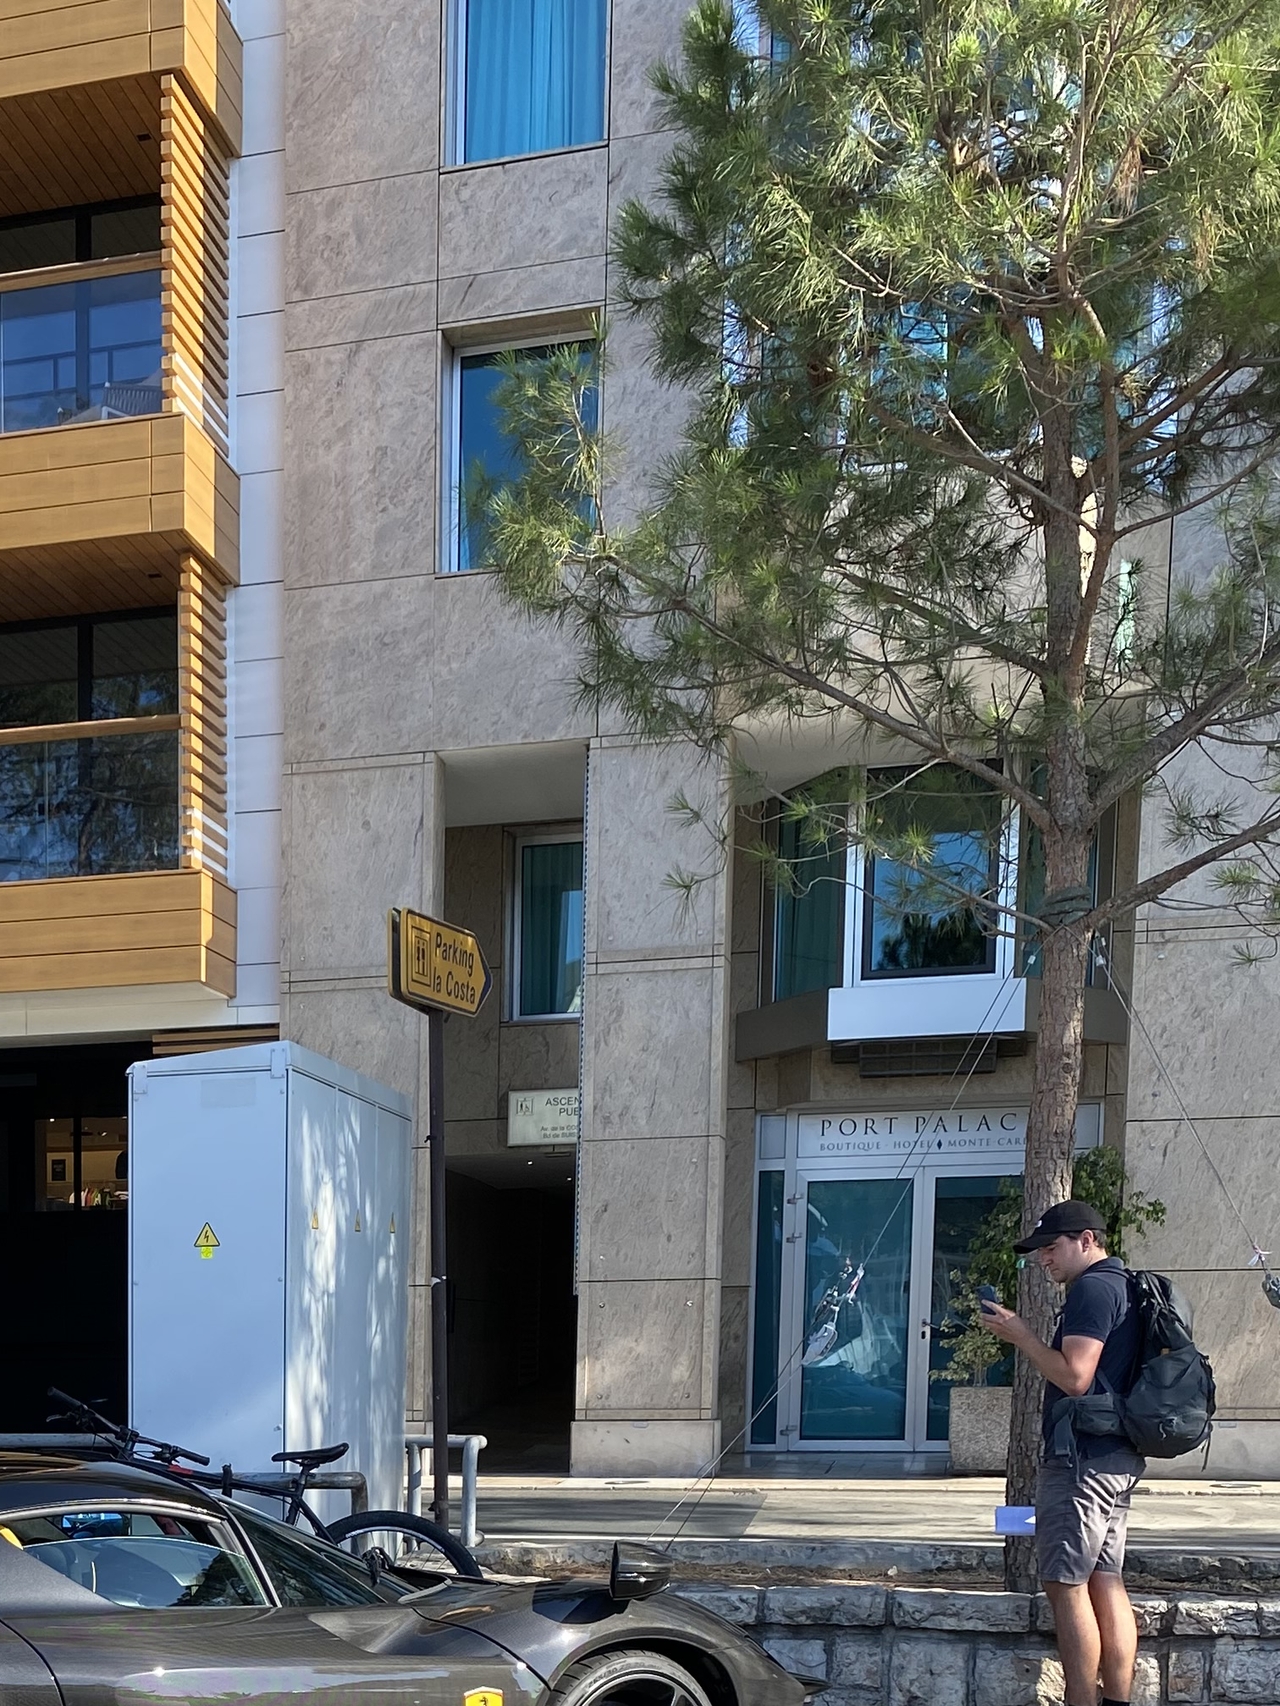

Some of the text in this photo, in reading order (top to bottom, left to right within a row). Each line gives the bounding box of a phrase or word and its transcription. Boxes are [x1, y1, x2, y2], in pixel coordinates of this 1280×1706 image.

[434, 932, 475, 978] Parking
[433, 966, 476, 1005] la Costa
[820, 1112, 1018, 1137] PORT PALAC
[820, 1139, 882, 1152] BOUTIQUE
[893, 1138, 932, 1150] HOTEL
